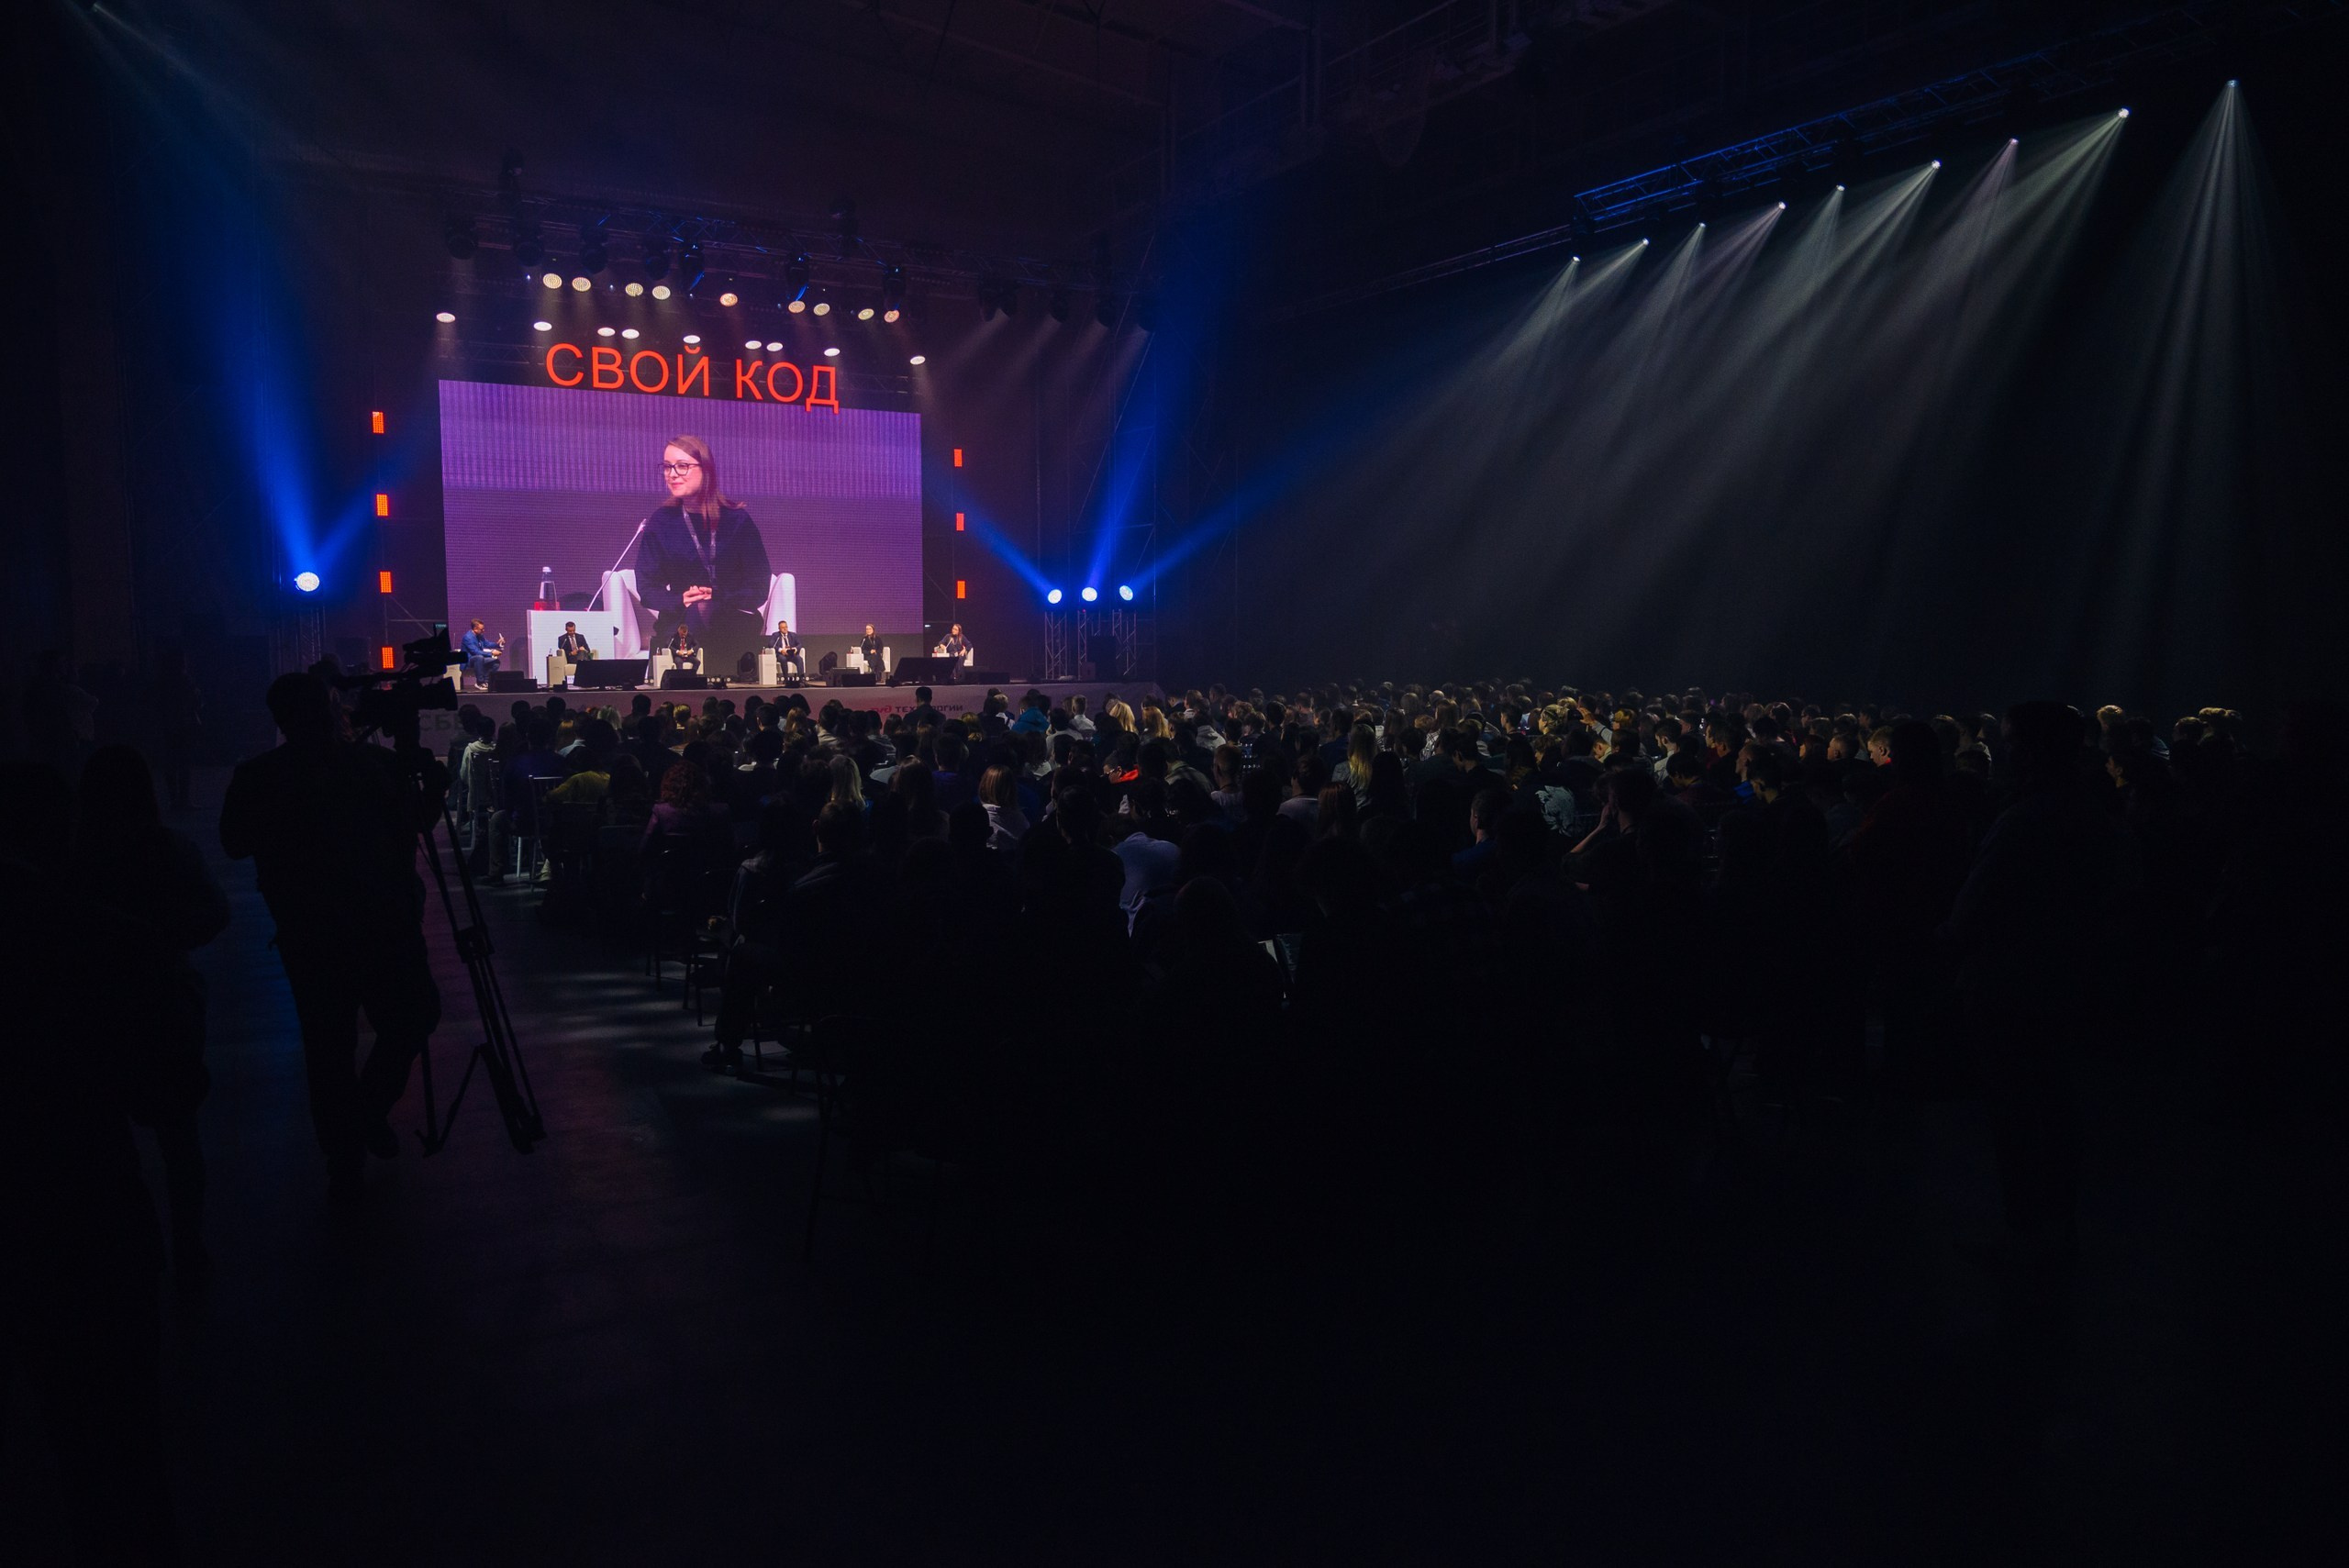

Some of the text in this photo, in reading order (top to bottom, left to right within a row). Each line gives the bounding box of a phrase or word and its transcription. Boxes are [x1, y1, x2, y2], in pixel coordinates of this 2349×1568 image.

[546, 343, 840, 414] СВОЙ КОД
[895, 705, 963, 713] ТЕХОГИИ
